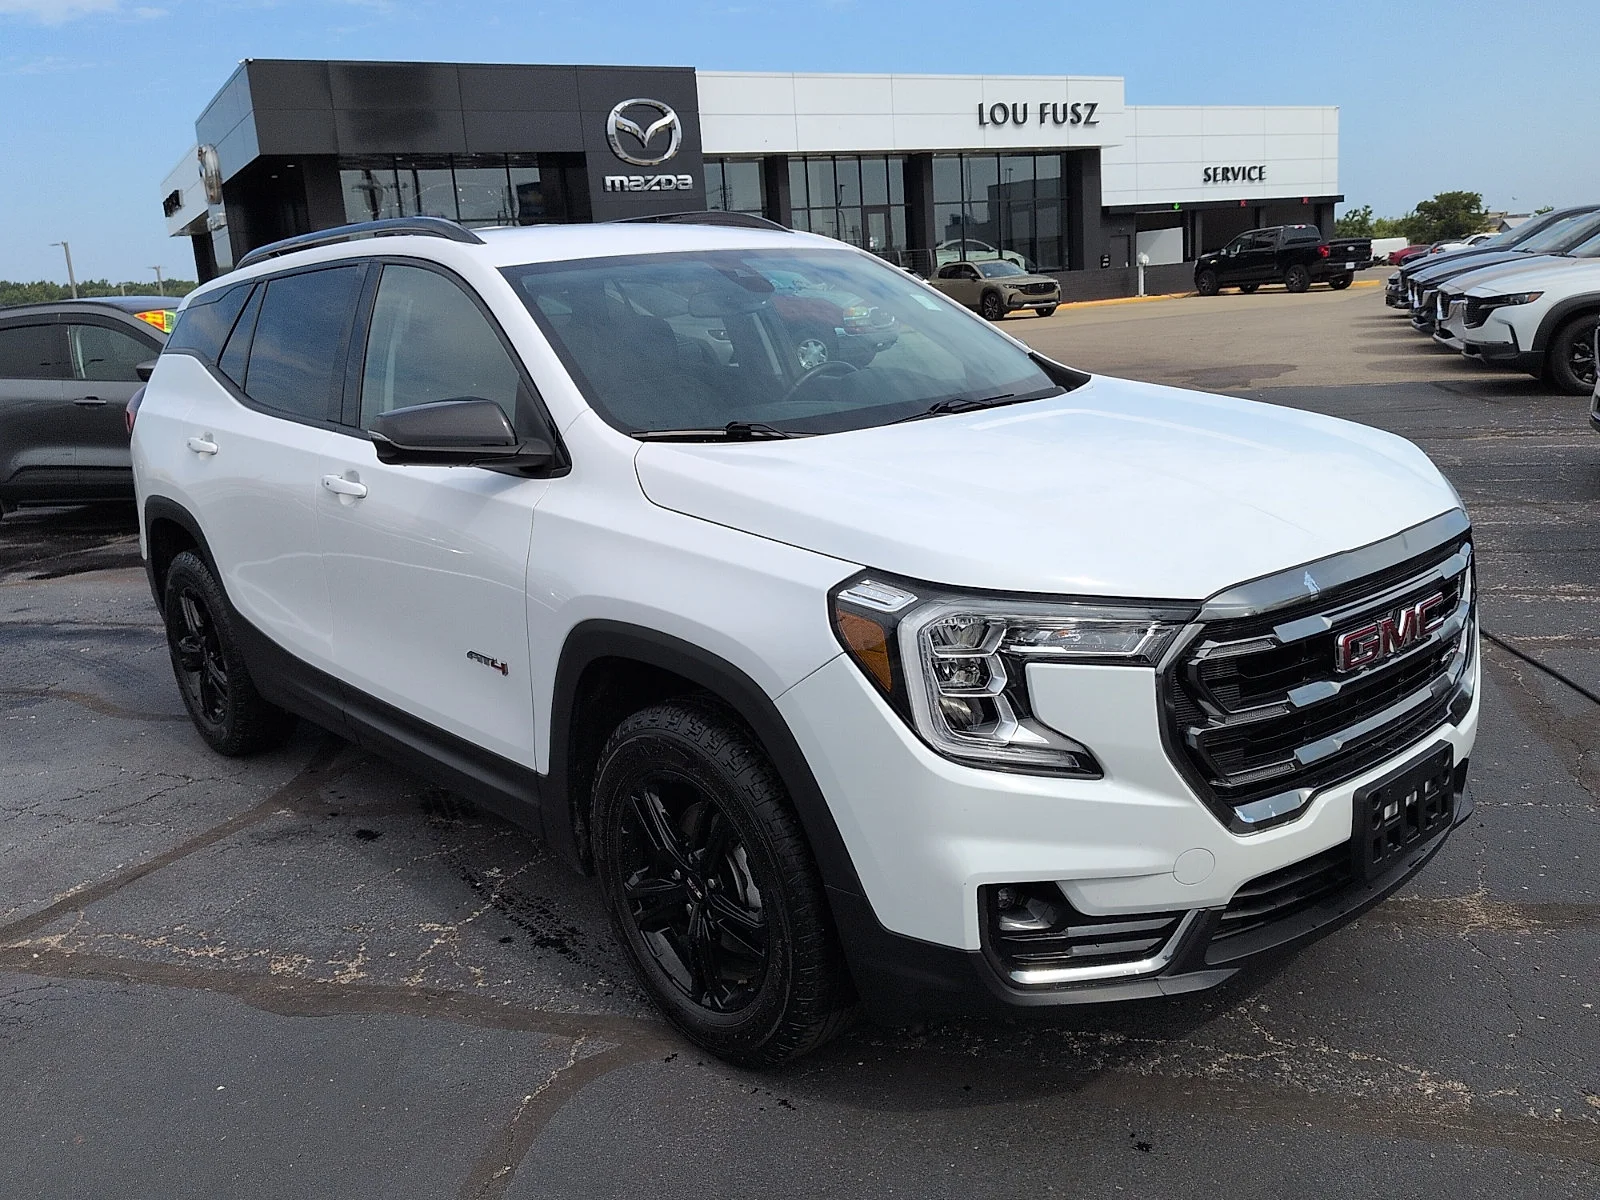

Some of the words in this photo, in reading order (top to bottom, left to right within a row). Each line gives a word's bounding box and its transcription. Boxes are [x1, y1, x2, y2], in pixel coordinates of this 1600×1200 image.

[978, 102, 1028, 125] LOU
[1040, 102, 1100, 125] FUSZ
[1203, 165, 1267, 182] SERVICE
[1334, 591, 1444, 674] GMC
[466, 650, 509, 677] AT4
